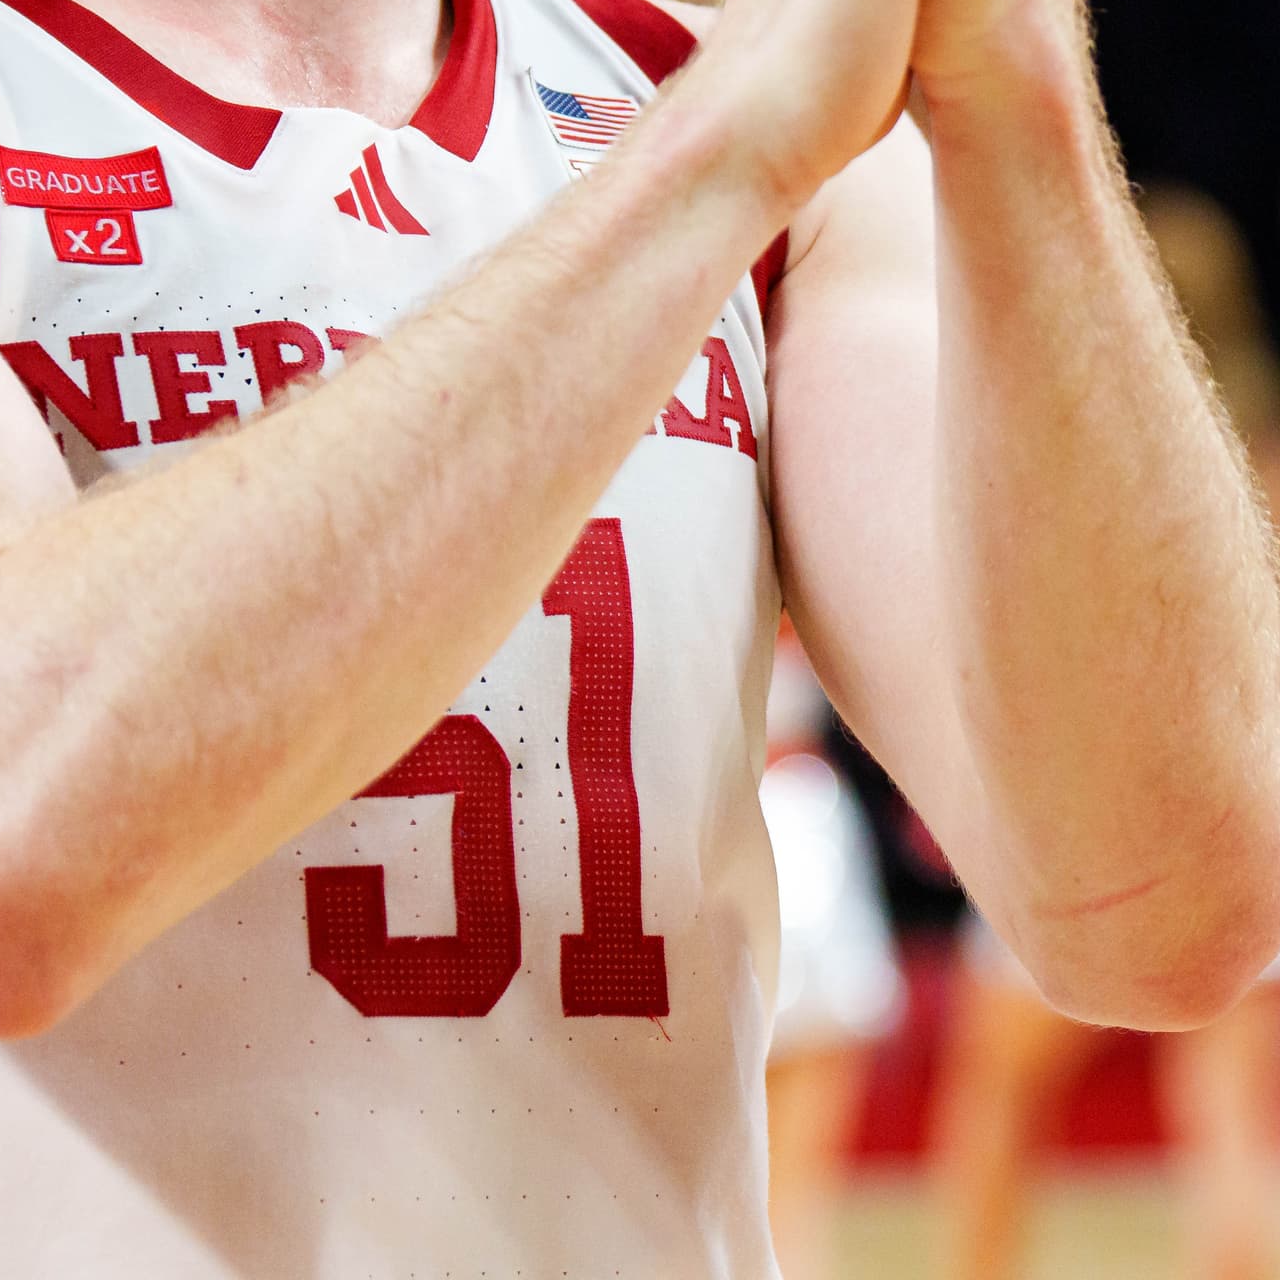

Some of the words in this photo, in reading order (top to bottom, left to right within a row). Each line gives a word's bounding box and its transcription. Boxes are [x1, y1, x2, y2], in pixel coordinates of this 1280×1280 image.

[6, 167, 161, 195] GRADUATE
[64, 218, 128, 256] x2
[304, 517, 670, 1017] 51
